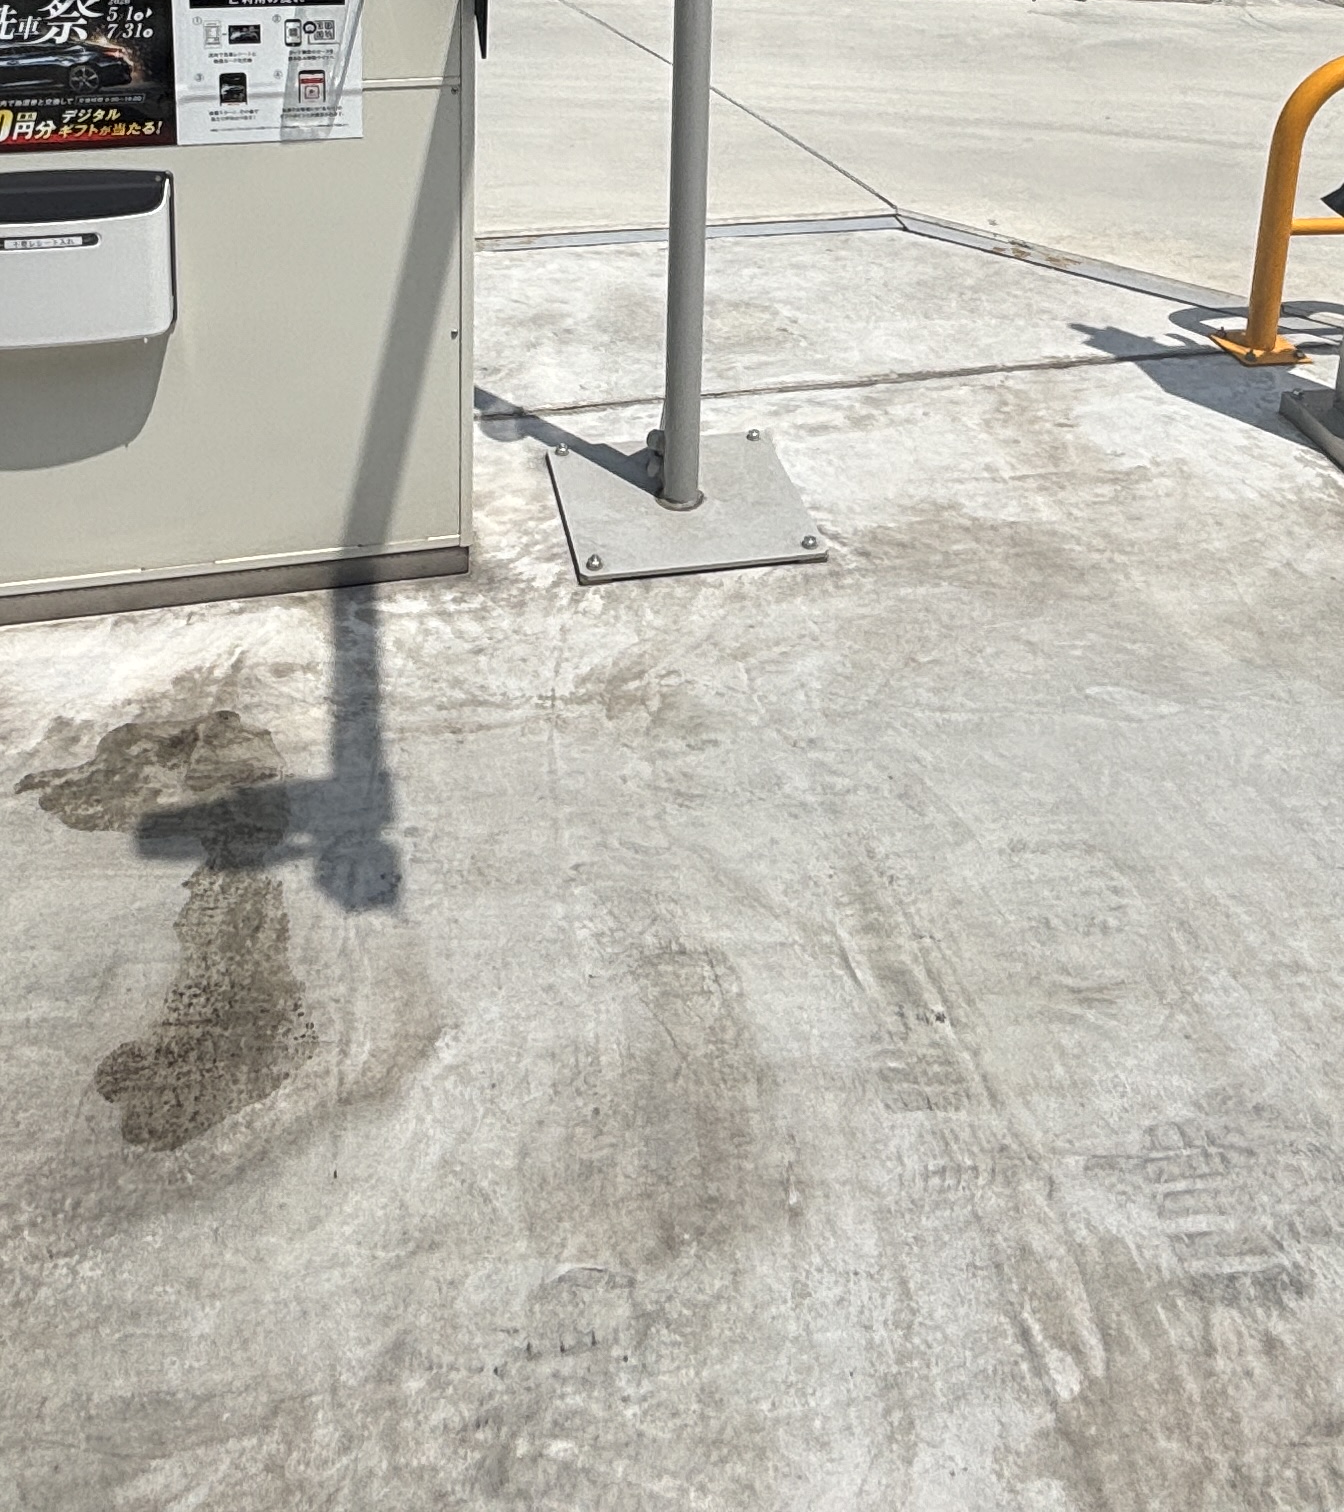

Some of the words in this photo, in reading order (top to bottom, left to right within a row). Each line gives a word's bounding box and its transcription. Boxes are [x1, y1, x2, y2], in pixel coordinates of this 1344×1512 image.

[60, 109, 122, 122] デジタル
[59, 121, 164, 140] ギフトが当たる!
